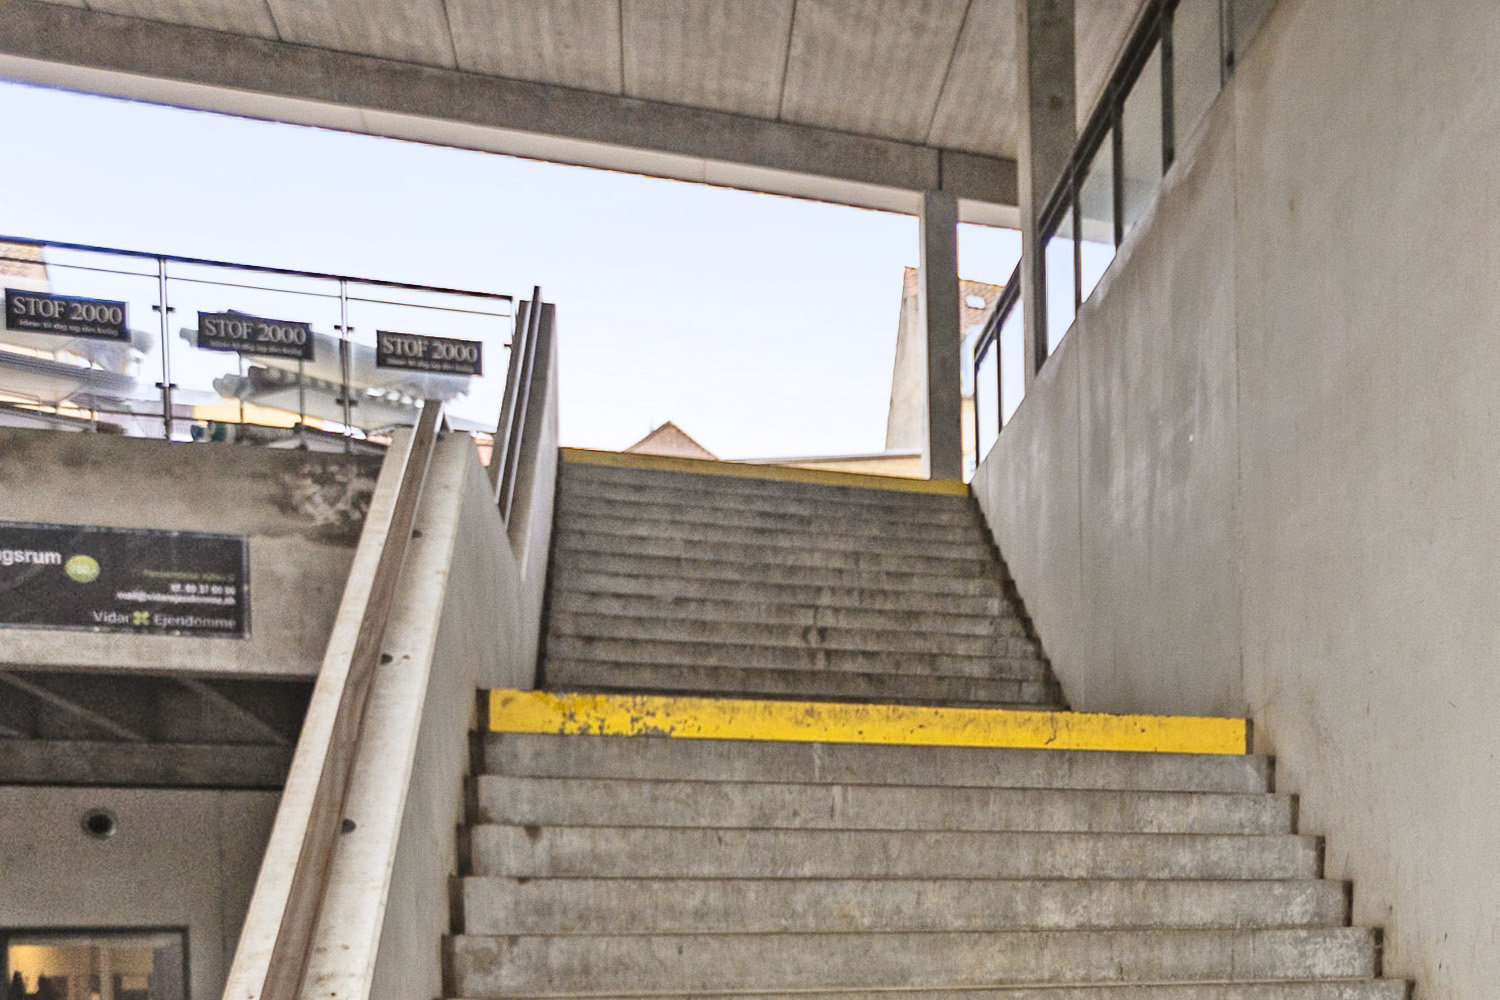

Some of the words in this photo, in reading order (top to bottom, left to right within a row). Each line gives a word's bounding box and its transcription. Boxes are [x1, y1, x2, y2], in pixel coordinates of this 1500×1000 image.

[13, 296, 65, 318] STOF
[70, 303, 122, 325] 2000
[203, 318, 253, 340] STOF
[258, 325, 307, 345] 2000
[380, 334, 428, 357] STOF
[431, 341, 478, 362] 2000
[93, 611, 130, 624] Vidar
